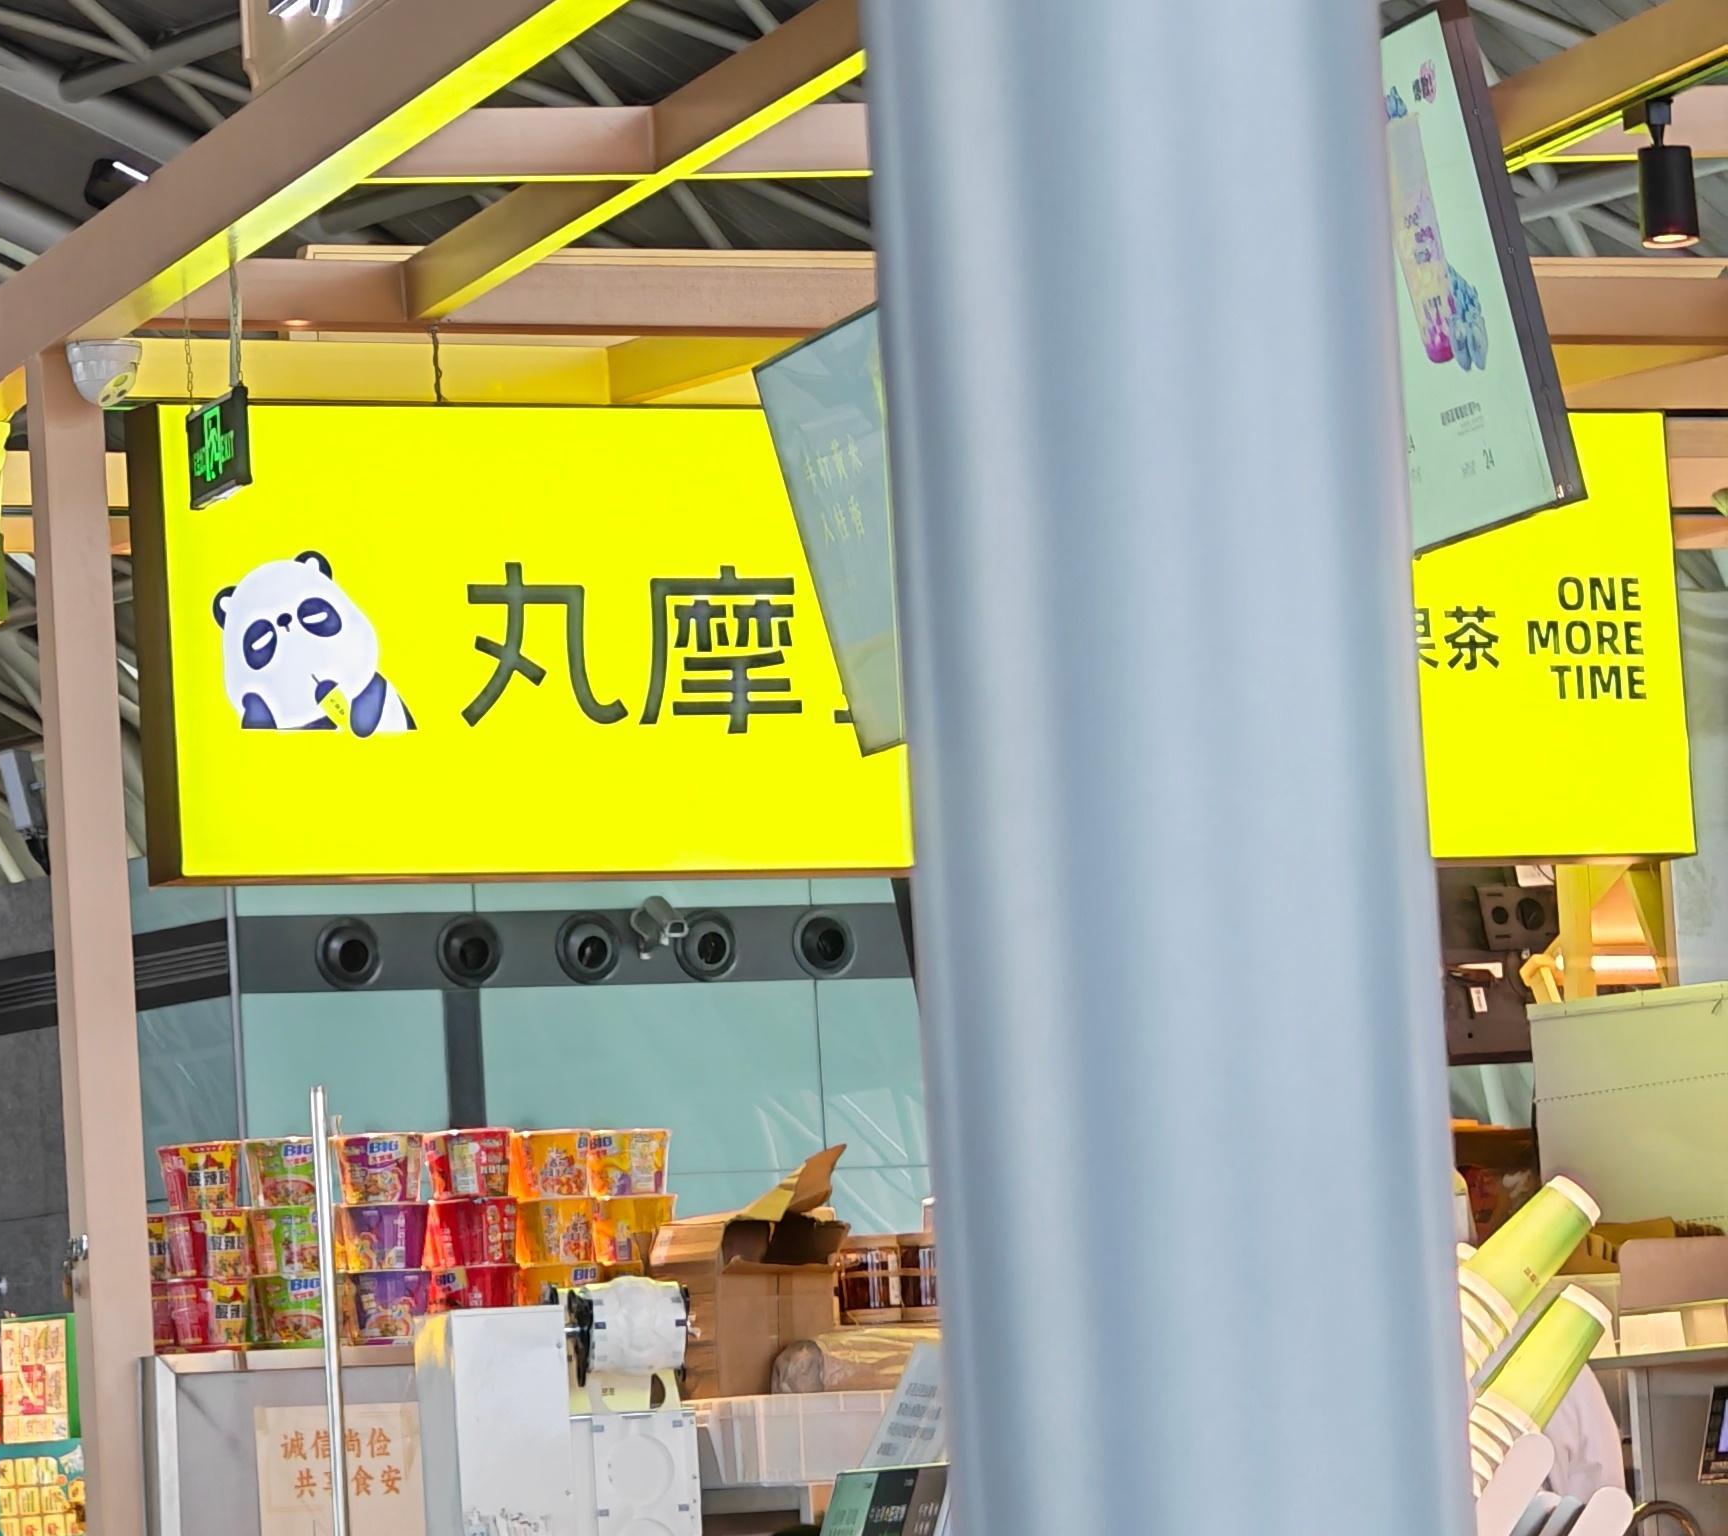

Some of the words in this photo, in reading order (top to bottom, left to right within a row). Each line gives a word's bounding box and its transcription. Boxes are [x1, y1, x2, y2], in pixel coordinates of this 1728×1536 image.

[1557, 576, 1642, 612] ONE
[460, 561, 856, 735] 丸摩
[1526, 619, 1645, 657] MORE
[1549, 664, 1648, 701] TIME
[281, 1427, 392, 1461] 诚信尚俭
